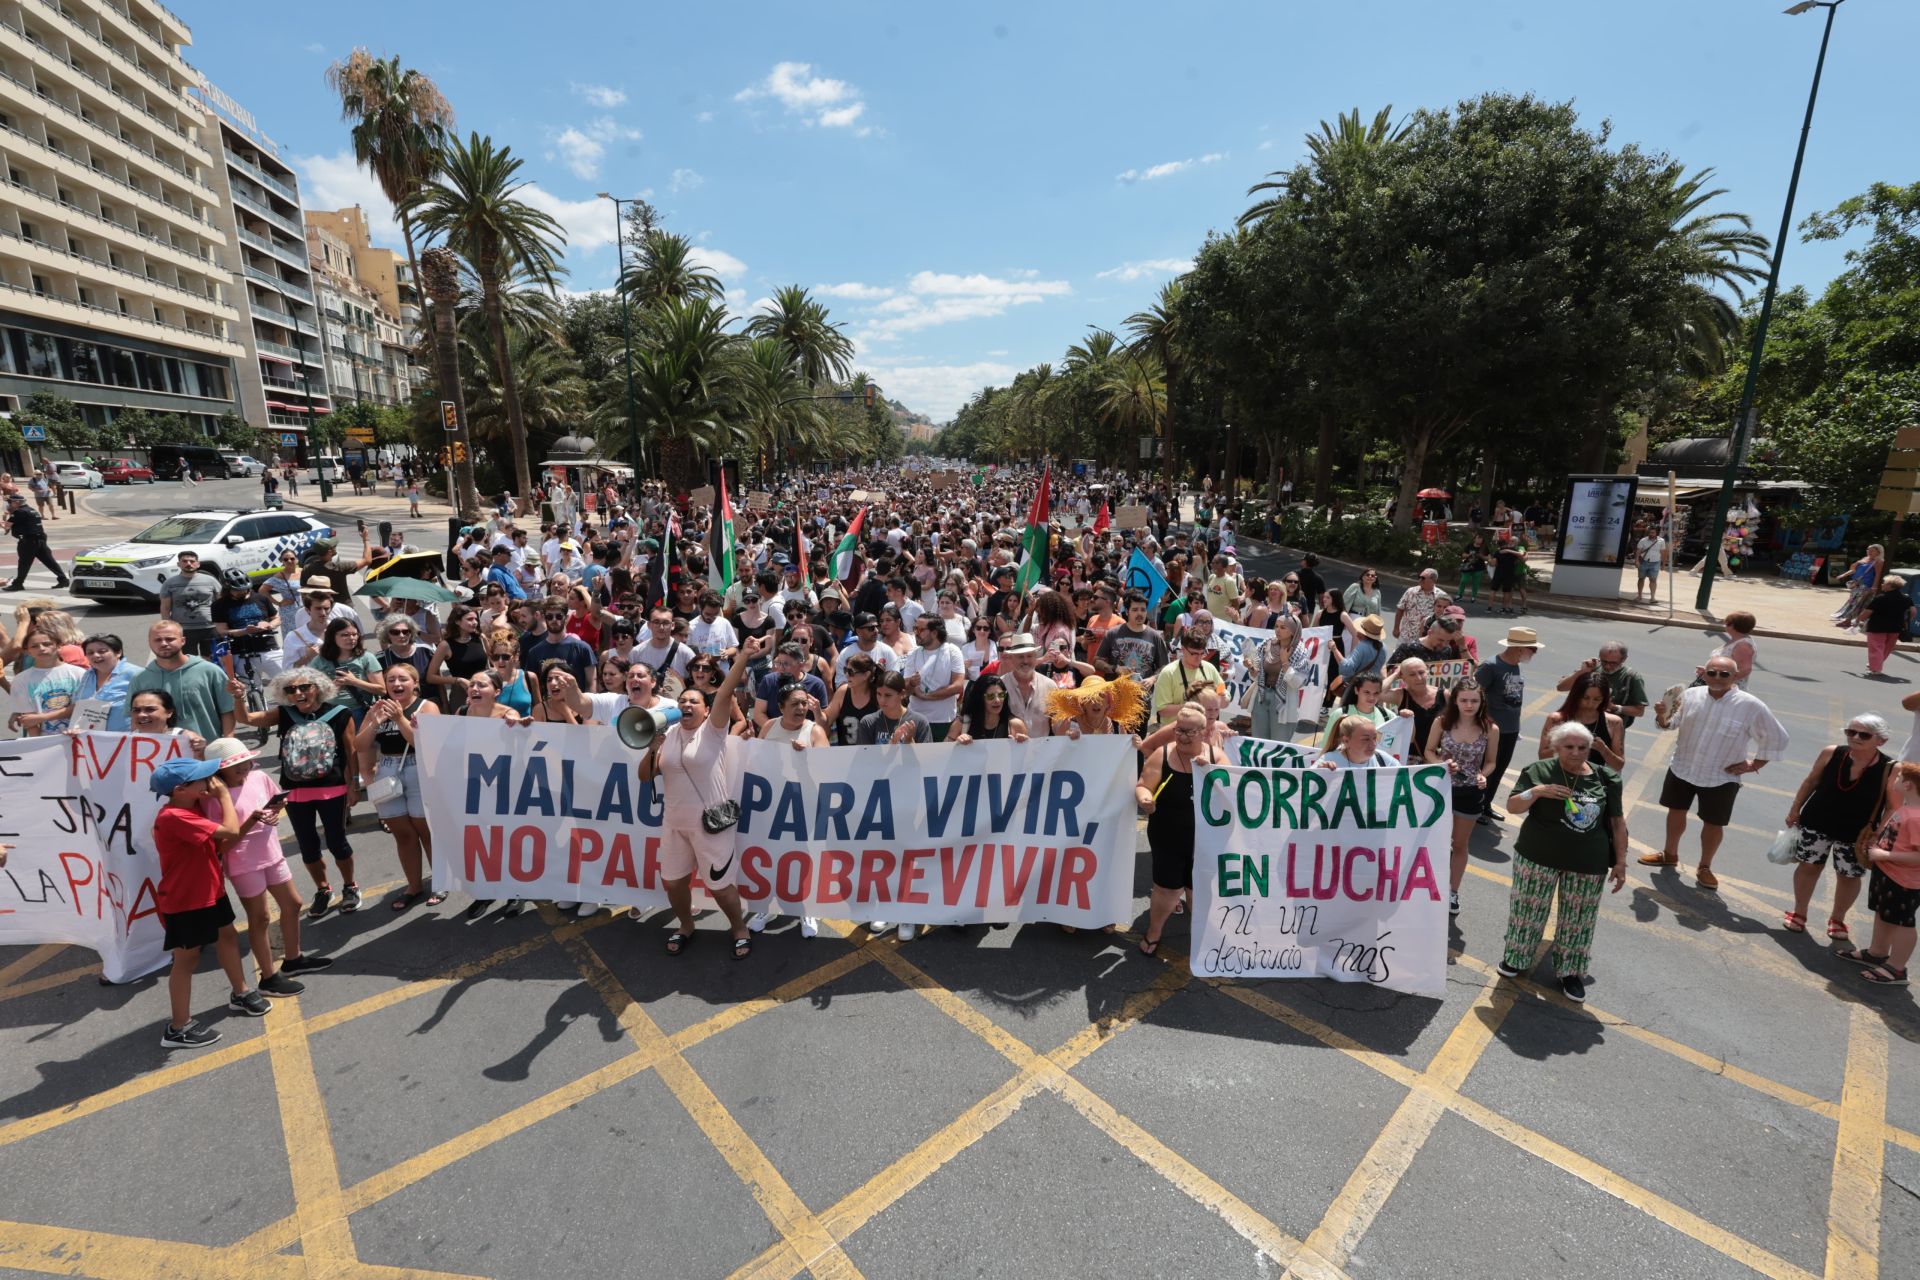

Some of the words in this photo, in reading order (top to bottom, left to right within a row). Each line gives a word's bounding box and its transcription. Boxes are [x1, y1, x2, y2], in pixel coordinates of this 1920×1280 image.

[1453, 661, 1469, 676] DE
[465, 741, 664, 827] MÁLAG
[737, 771, 896, 842] PARA
[923, 770, 1099, 845] VIVIR,
[1201, 766, 1447, 830] CORRALAS
[464, 825, 547, 883] NO
[738, 843, 1098, 910] SOBREVIVIR
[1218, 853, 1269, 898] EN
[1286, 843, 1442, 902] LUCHA
[1217, 900, 1257, 935] ni
[1280, 904, 1320, 936] un
[1204, 935, 1302, 975] desahucio
[1328, 931, 1397, 983] más
